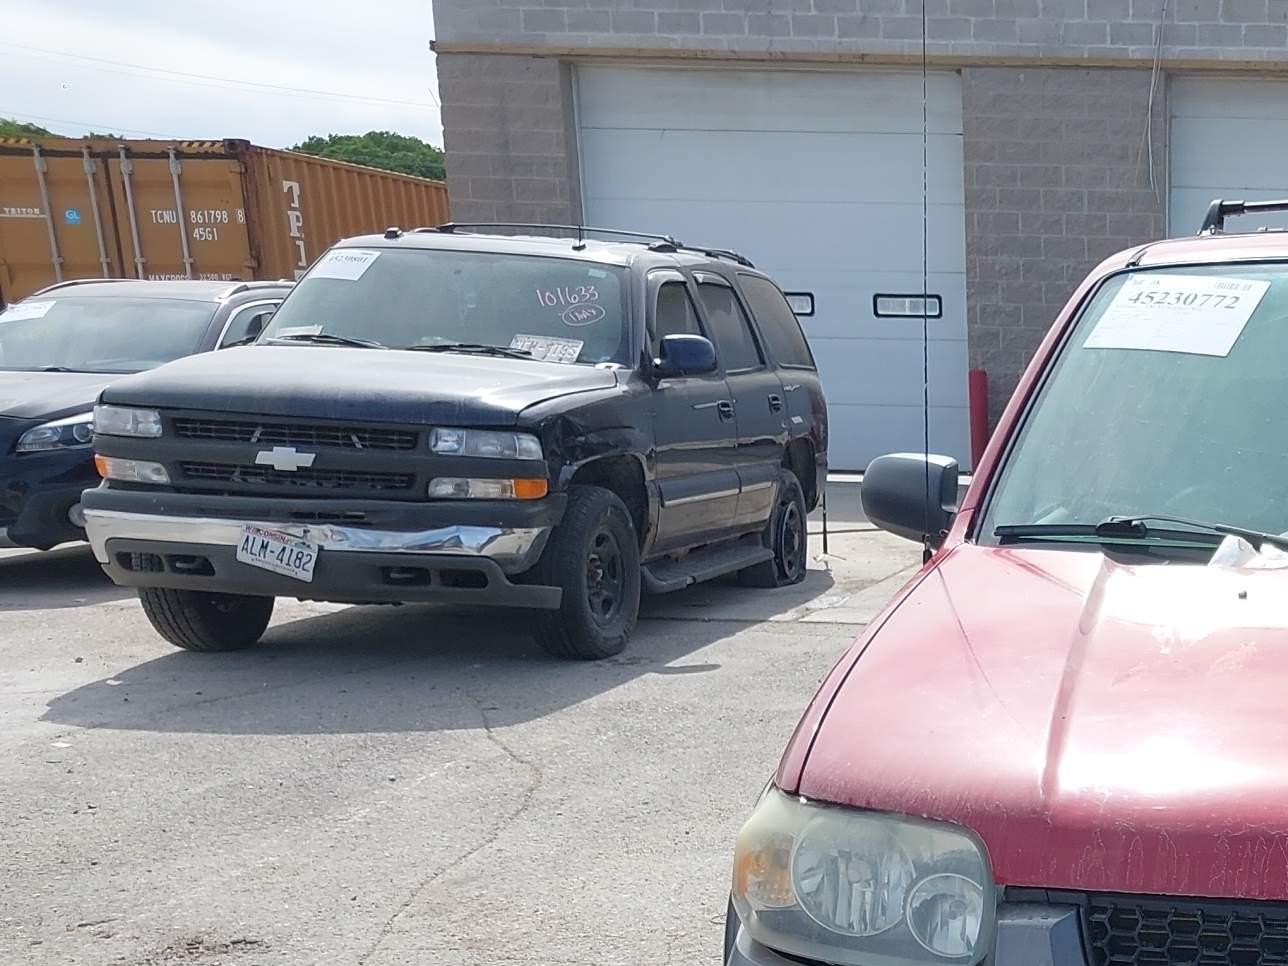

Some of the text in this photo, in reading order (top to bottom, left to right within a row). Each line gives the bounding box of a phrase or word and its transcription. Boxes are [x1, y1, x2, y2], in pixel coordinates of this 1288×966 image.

[150, 209, 245, 224] TCNU 861798 8
[193, 227, 218, 241] 45G1
[536, 285, 599, 307] 101633
[1128, 291, 1241, 309] 45230772
[241, 535, 312, 572] ALM-4182
